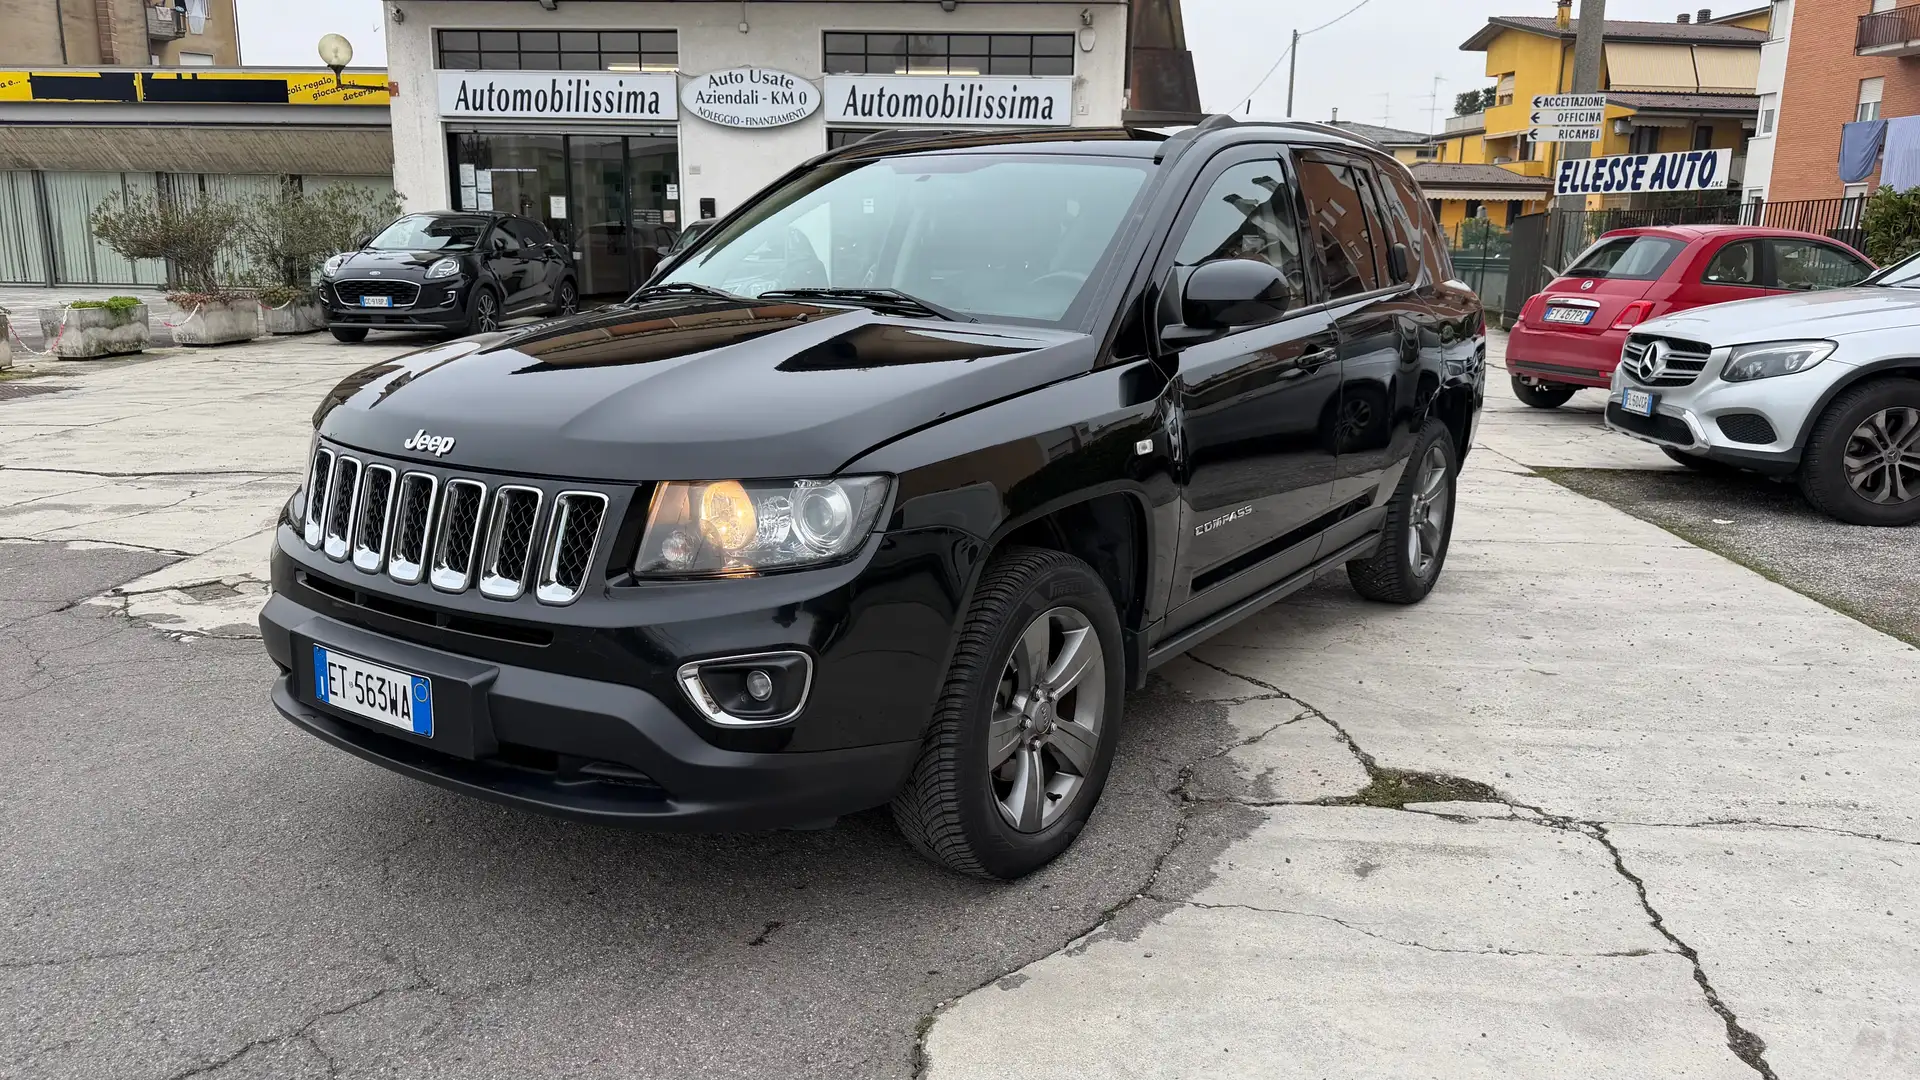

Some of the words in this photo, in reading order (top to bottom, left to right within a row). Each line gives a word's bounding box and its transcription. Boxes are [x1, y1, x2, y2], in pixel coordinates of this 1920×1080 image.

[303, 77, 334, 90] regalo,
[708, 71, 744, 89] Auto
[749, 69, 794, 90] Usate
[454, 79, 660, 115] Automobilissima
[695, 89, 759, 104] Aziendali
[771, 91, 795, 105] KM
[799, 91, 807, 105] 0
[842, 83, 1054, 119] Automobilissima
[1543, 97, 1605, 107] ACCETTAZIONE
[697, 107, 740, 125] NOLEGGIO
[745, 107, 807, 126] FINANZIAMENTI
[1557, 112, 1602, 123] OFFICINA
[1558, 129, 1600, 139] RICAMBI
[1558, 155, 1649, 194] ELLESSE
[1649, 150, 1718, 190] AUTO
[404, 429, 456, 458] Jeep
[1194, 504, 1253, 537] COMPASS
